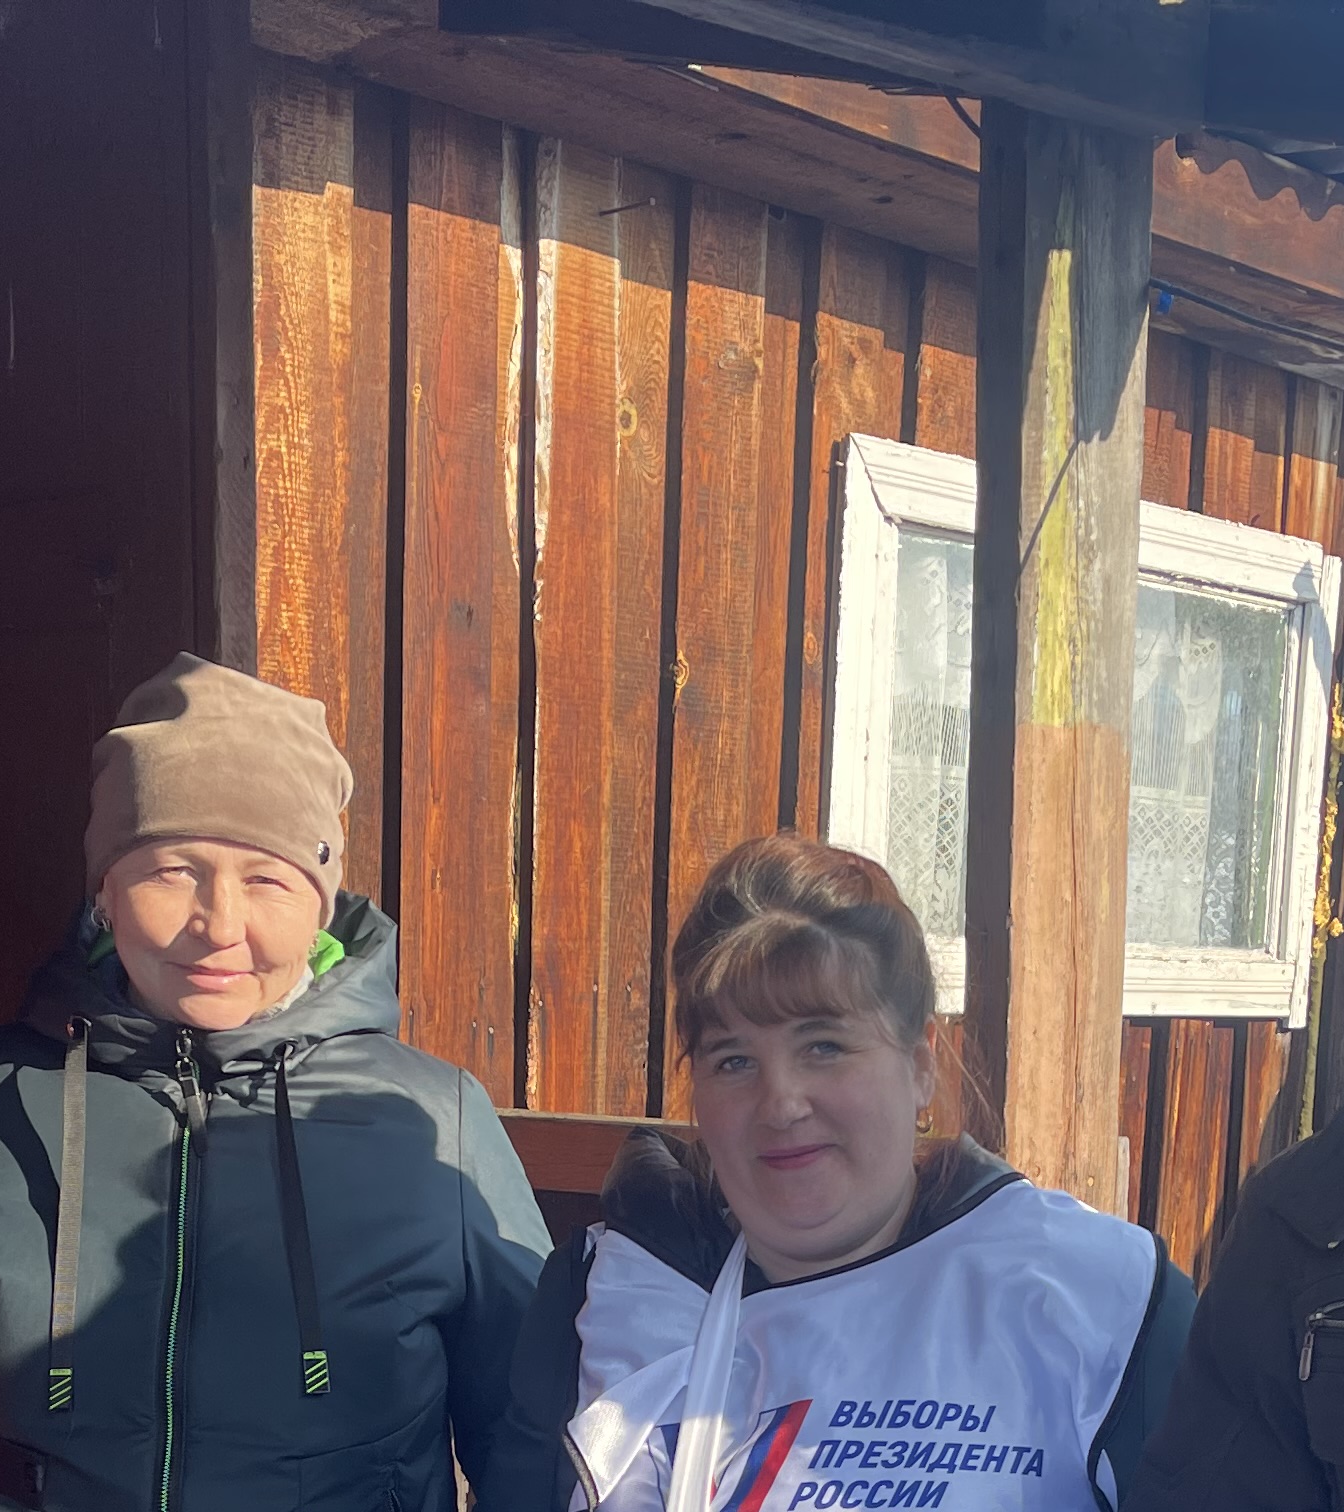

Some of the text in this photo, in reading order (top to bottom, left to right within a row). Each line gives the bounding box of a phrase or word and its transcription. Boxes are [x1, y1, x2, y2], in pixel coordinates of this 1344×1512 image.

[828, 1400, 997, 1432] ВЫБОРЫ
[808, 1440, 1045, 1477] ПРЕЗИДЕНТА
[788, 1480, 949, 1512] РОССИИ
